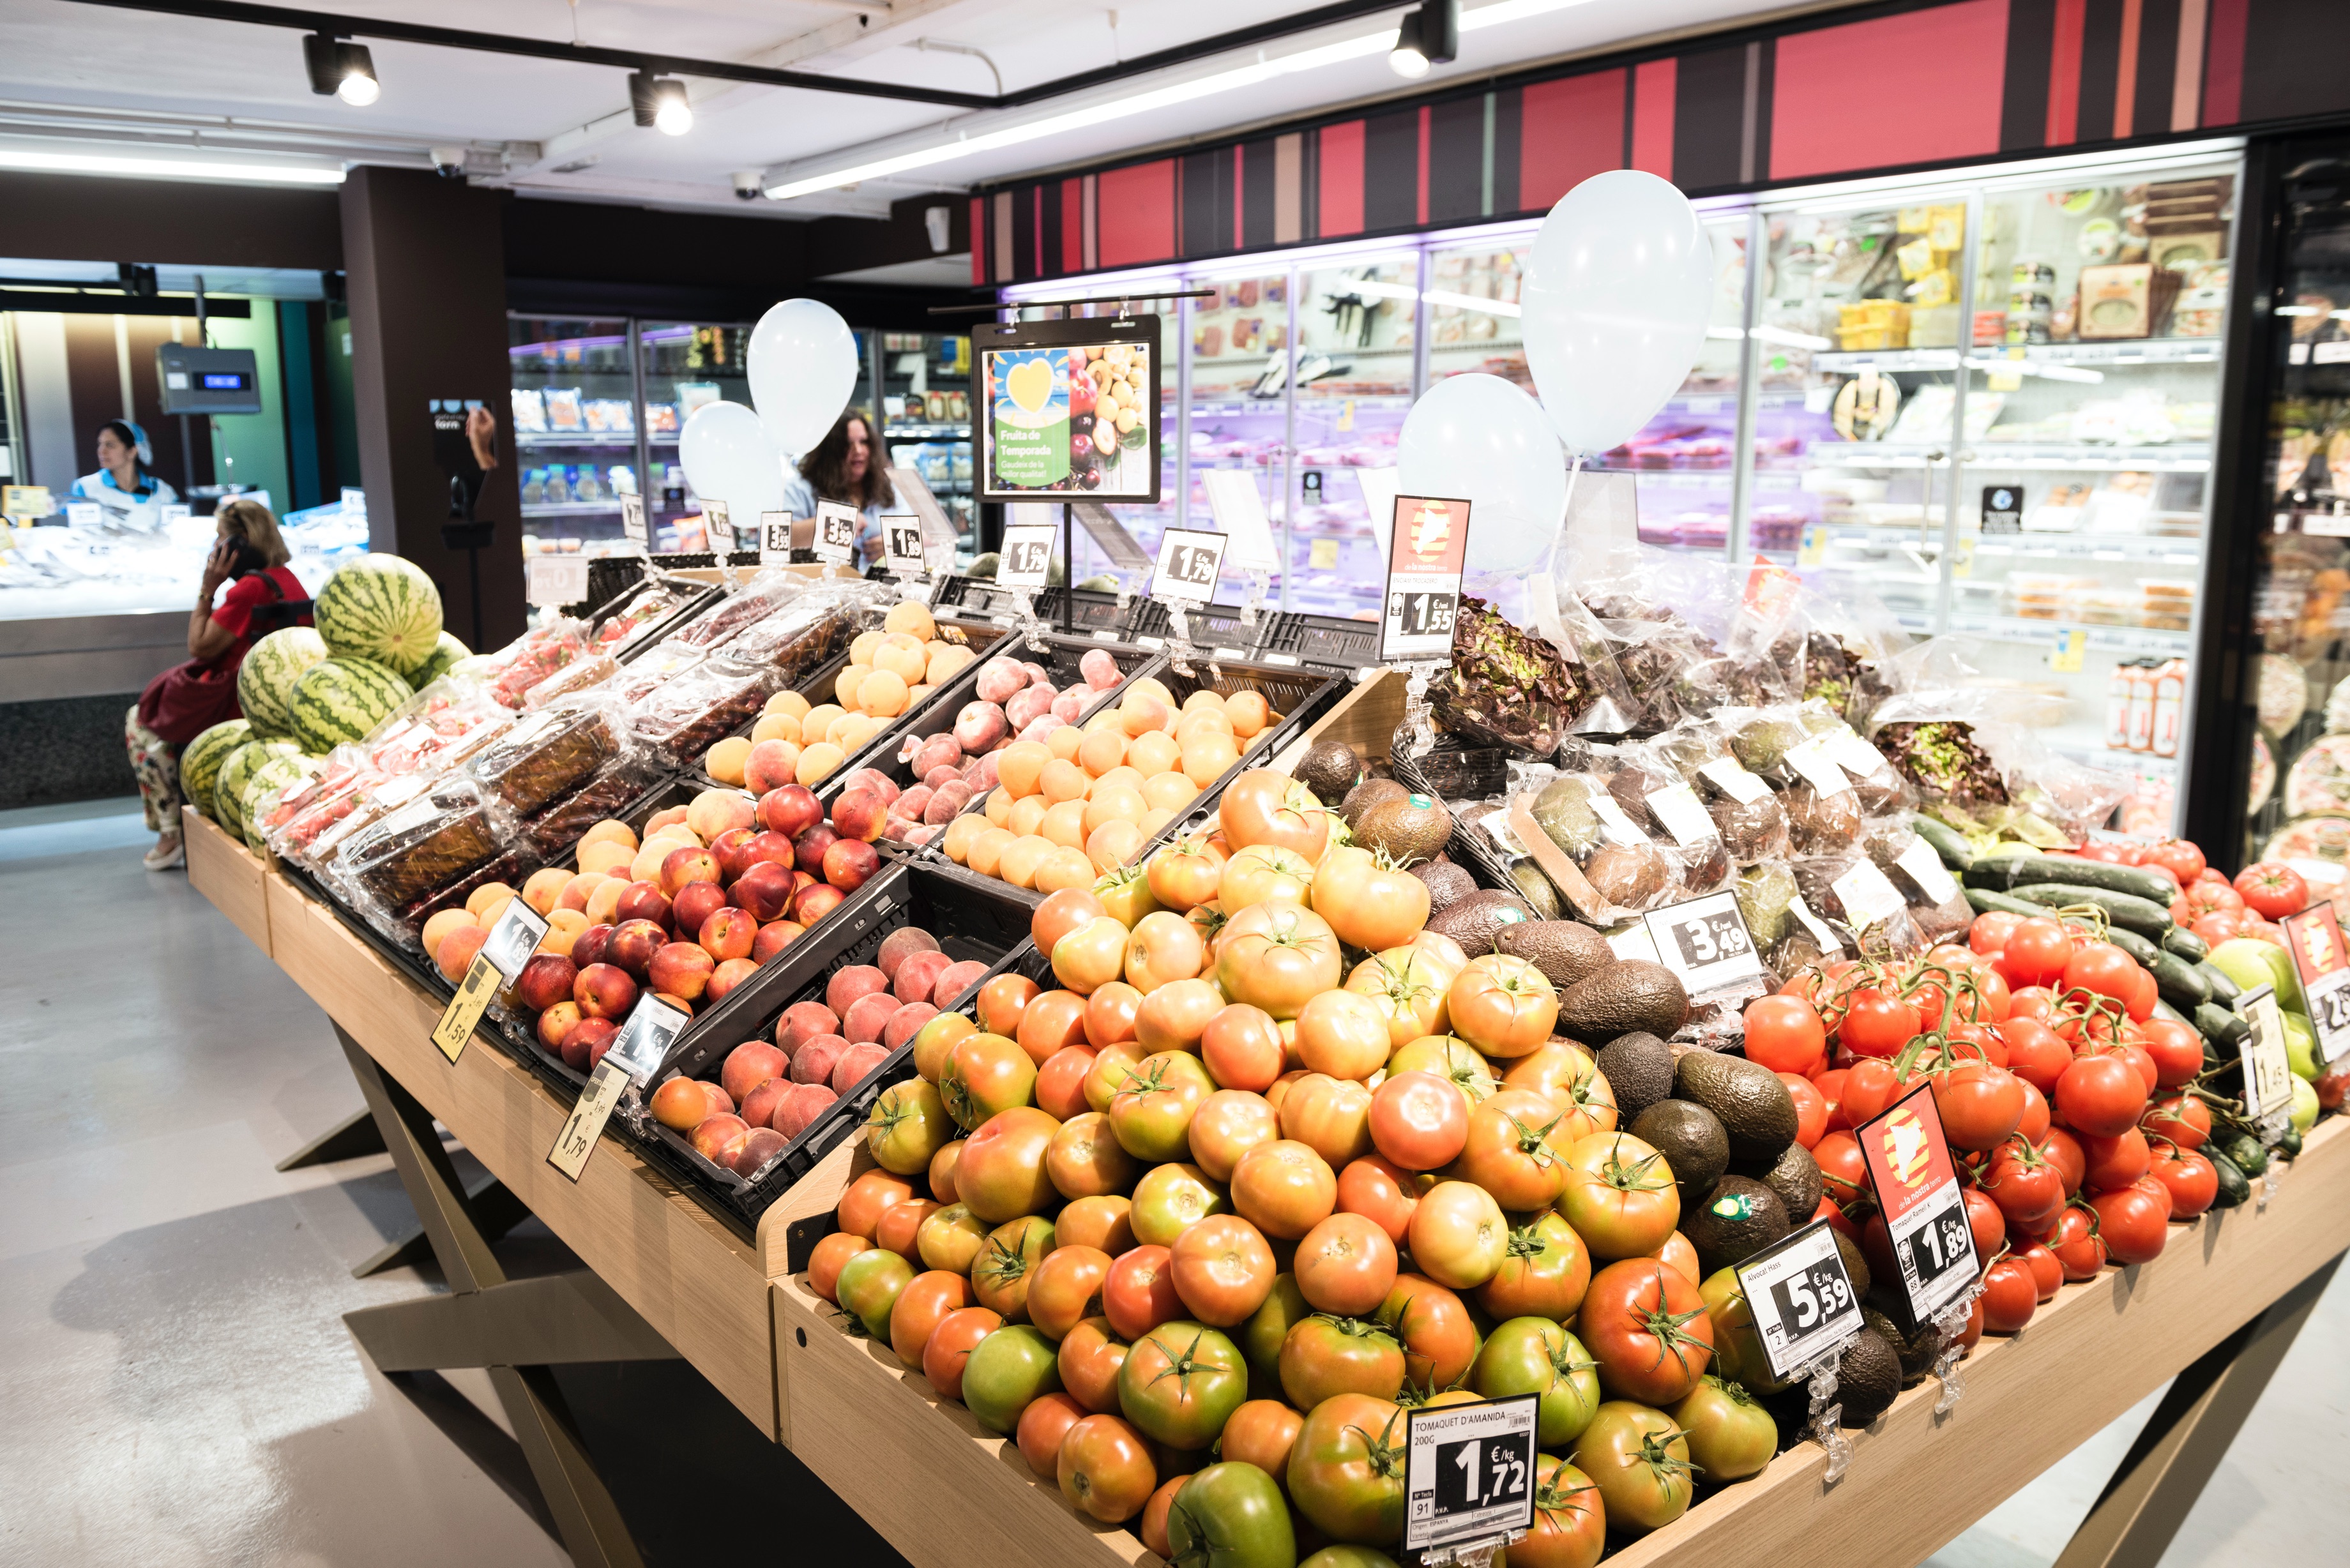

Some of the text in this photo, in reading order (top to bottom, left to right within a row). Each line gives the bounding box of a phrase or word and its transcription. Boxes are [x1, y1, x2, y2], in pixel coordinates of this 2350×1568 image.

[1000, 430, 1041, 441] Fruita de
[1000, 444, 1052, 458] Temporada
[1001, 460, 1028, 469] Gaudeix
[1019, 470, 1047, 479] qualitat!
[770, 525, 789, 551] 3,55
[827, 517, 853, 545] 3,99
[896, 529, 921, 558] 1,89
[1017, 542, 1046, 573] 1,79
[1179, 547, 1213, 582] 1,79
[1411, 562, 1417, 571] la
[1413, 593, 1452, 635] 1,55
[1685, 918, 1747, 961] 3,49
[444, 1002, 466, 1044] 1,59
[590, 1076, 603, 1086] OFERTA
[562, 1113, 587, 1158] 1,79
[1899, 1202, 1906, 1210] de
[1904, 1196, 1911, 1206] la
[1911, 1183, 1930, 1202] nostra
[1930, 1175, 1941, 1188] terra
[1891, 1214, 1913, 1232] Tomaquet
[1912, 1205, 1927, 1218] Ramell
[1922, 1221, 1967, 1270] 1,89
[1747, 1261, 1782, 1283] Alvocat Hass
[1910, 1279, 1918, 1291] 88
[1786, 1270, 1849, 1328] 5,59
[1772, 1324, 1782, 1332] Tecla
[1788, 1333, 1800, 1342] P.V.P.
[1775, 1336, 1782, 1345] 2
[1415, 1417, 1459, 1433] TOMAQUET
[1460, 1411, 1506, 1426] D'AMANIDA
[1414, 1435, 1435, 1446] 200G
[1455, 1440, 1526, 1507] 1,72
[1416, 1502, 1429, 1516] 91
[1435, 1506, 1449, 1515] P.V.P.
[1429, 1519, 1449, 1528] ESPANYA
